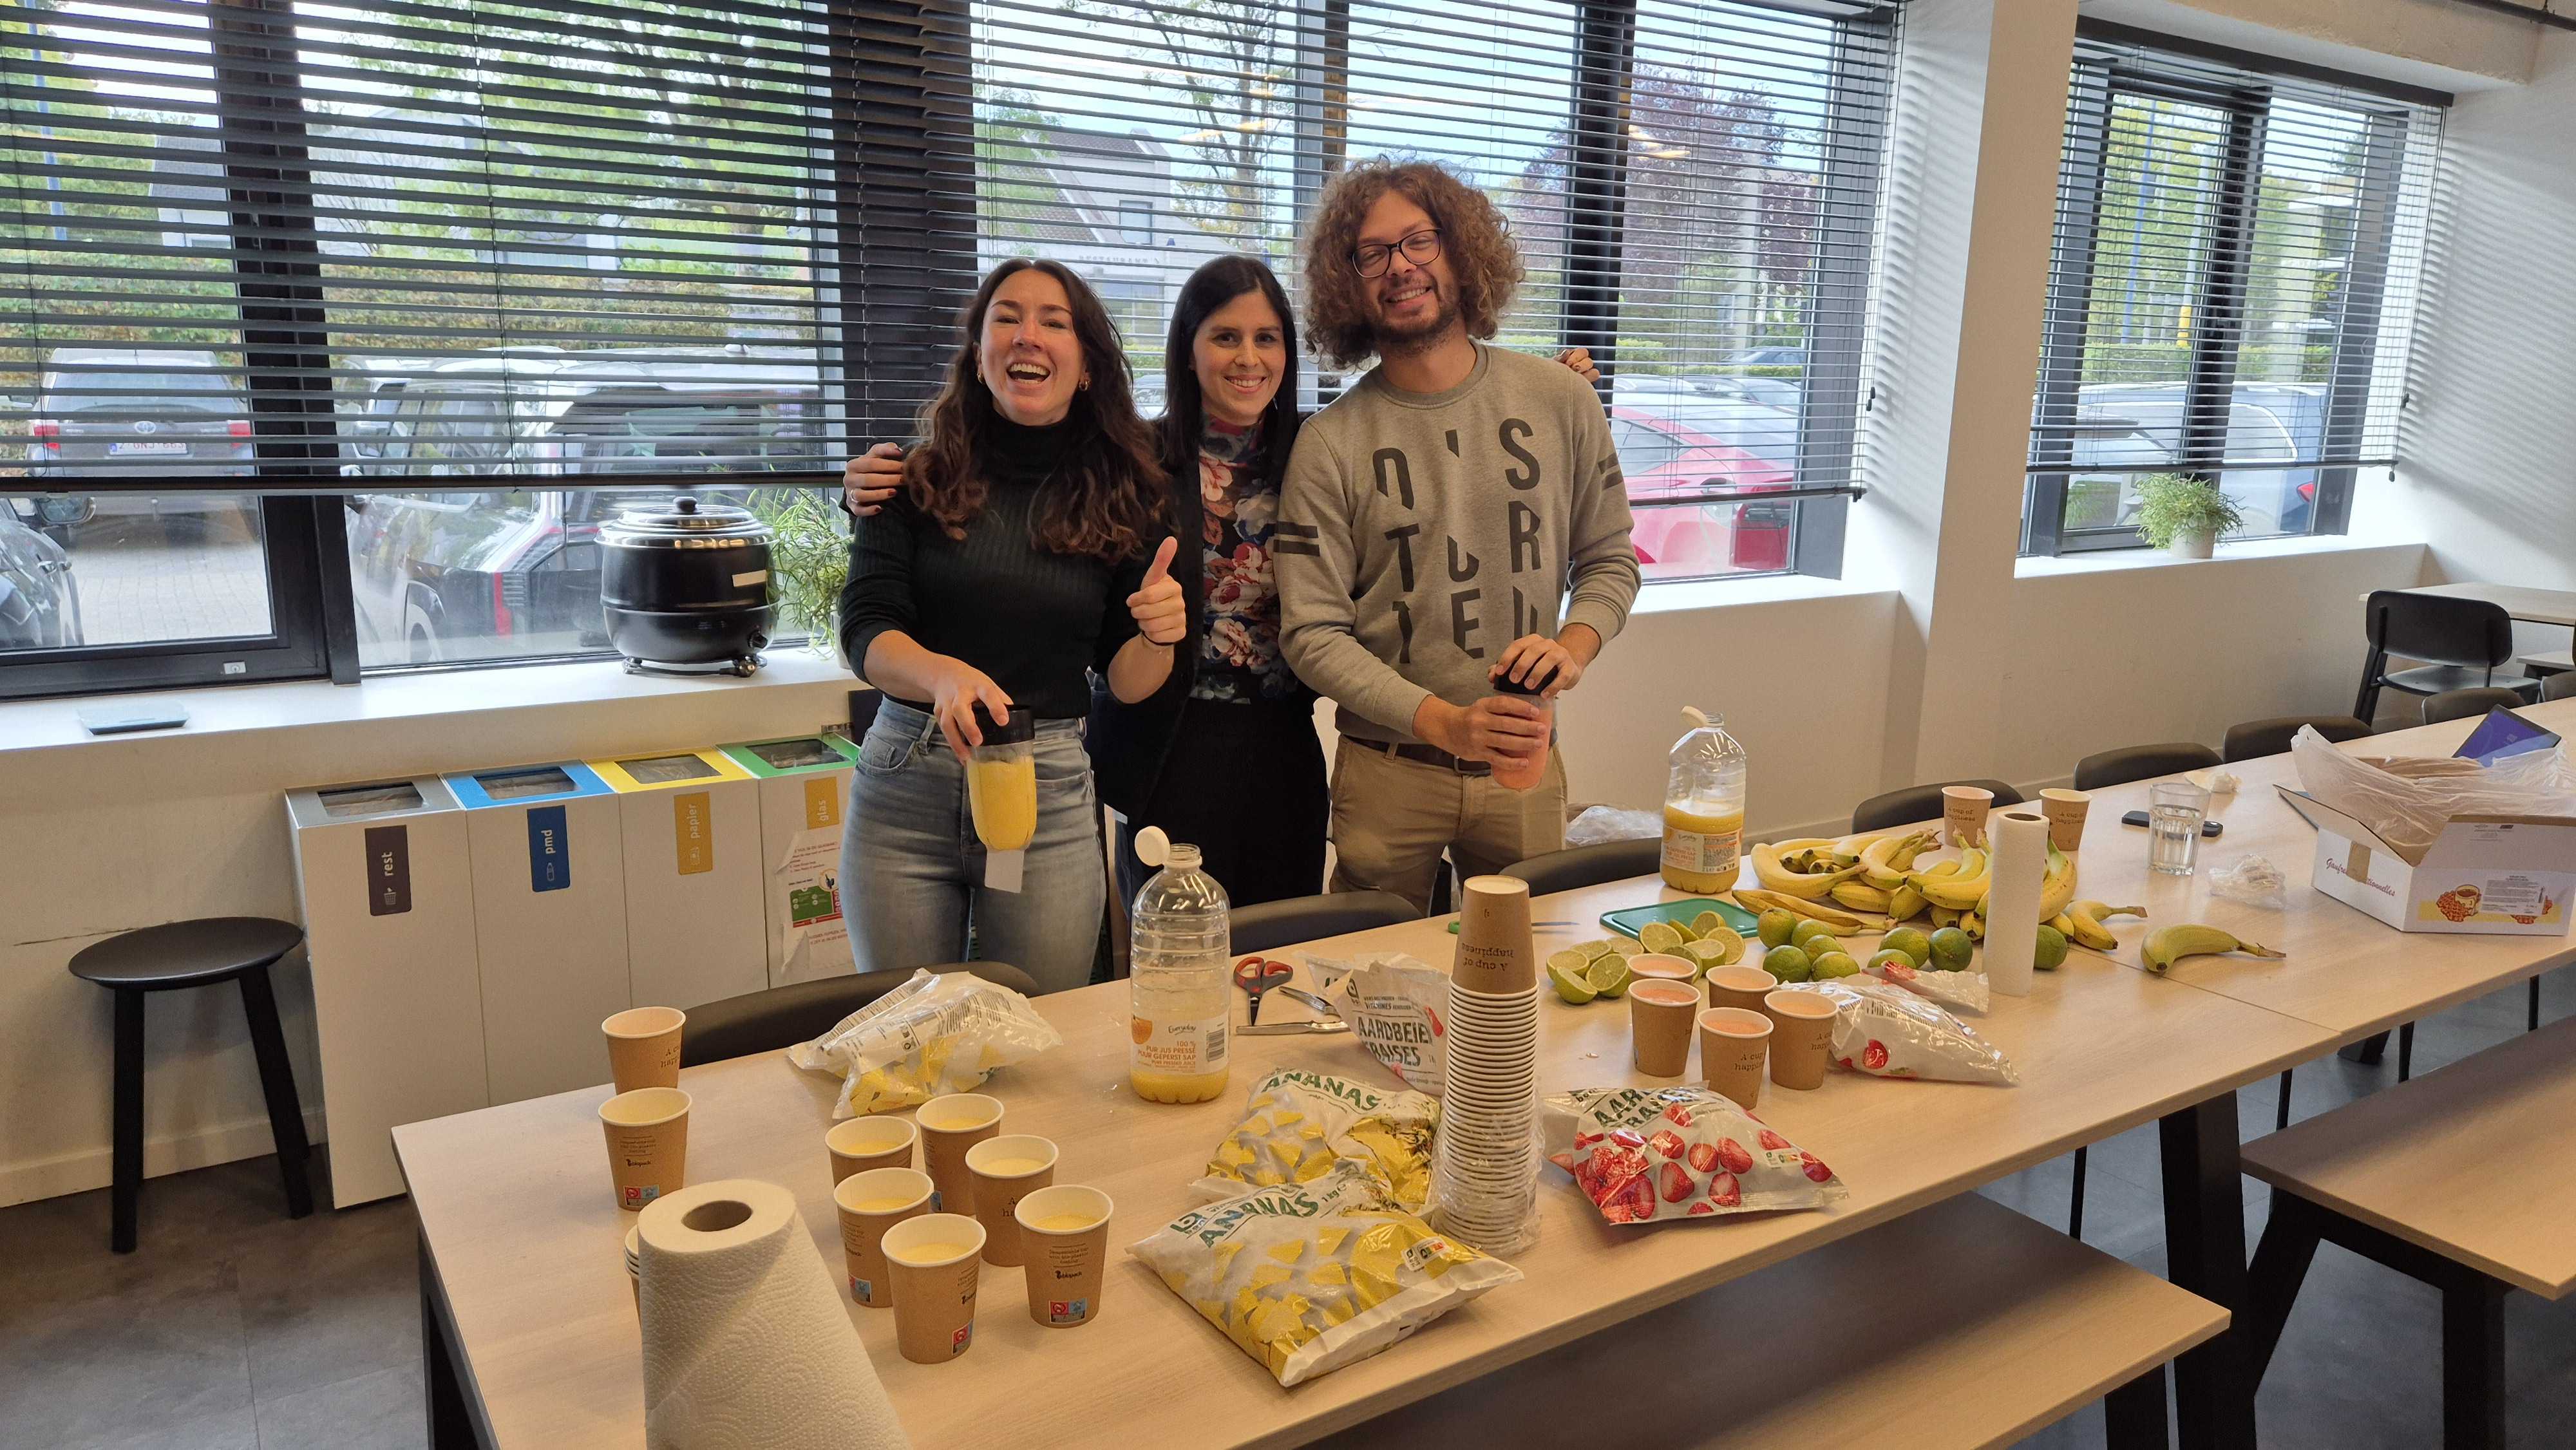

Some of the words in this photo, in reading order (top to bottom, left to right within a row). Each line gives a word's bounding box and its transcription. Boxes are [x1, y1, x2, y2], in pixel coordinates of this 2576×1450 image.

[687, 804, 701, 840] papier
[818, 800, 829, 822] glas
[541, 829, 556, 854] pmd
[381, 851, 393, 876] rest
[1463, 957, 1473, 966] of
[1475, 959, 1496, 970] cup
[1500, 963, 1508, 971] A
[1168, 1023, 1197, 1034] Everyday
[1261, 1072, 1383, 1111] ANANAS
[1199, 1191, 1319, 1248] ANANAS
